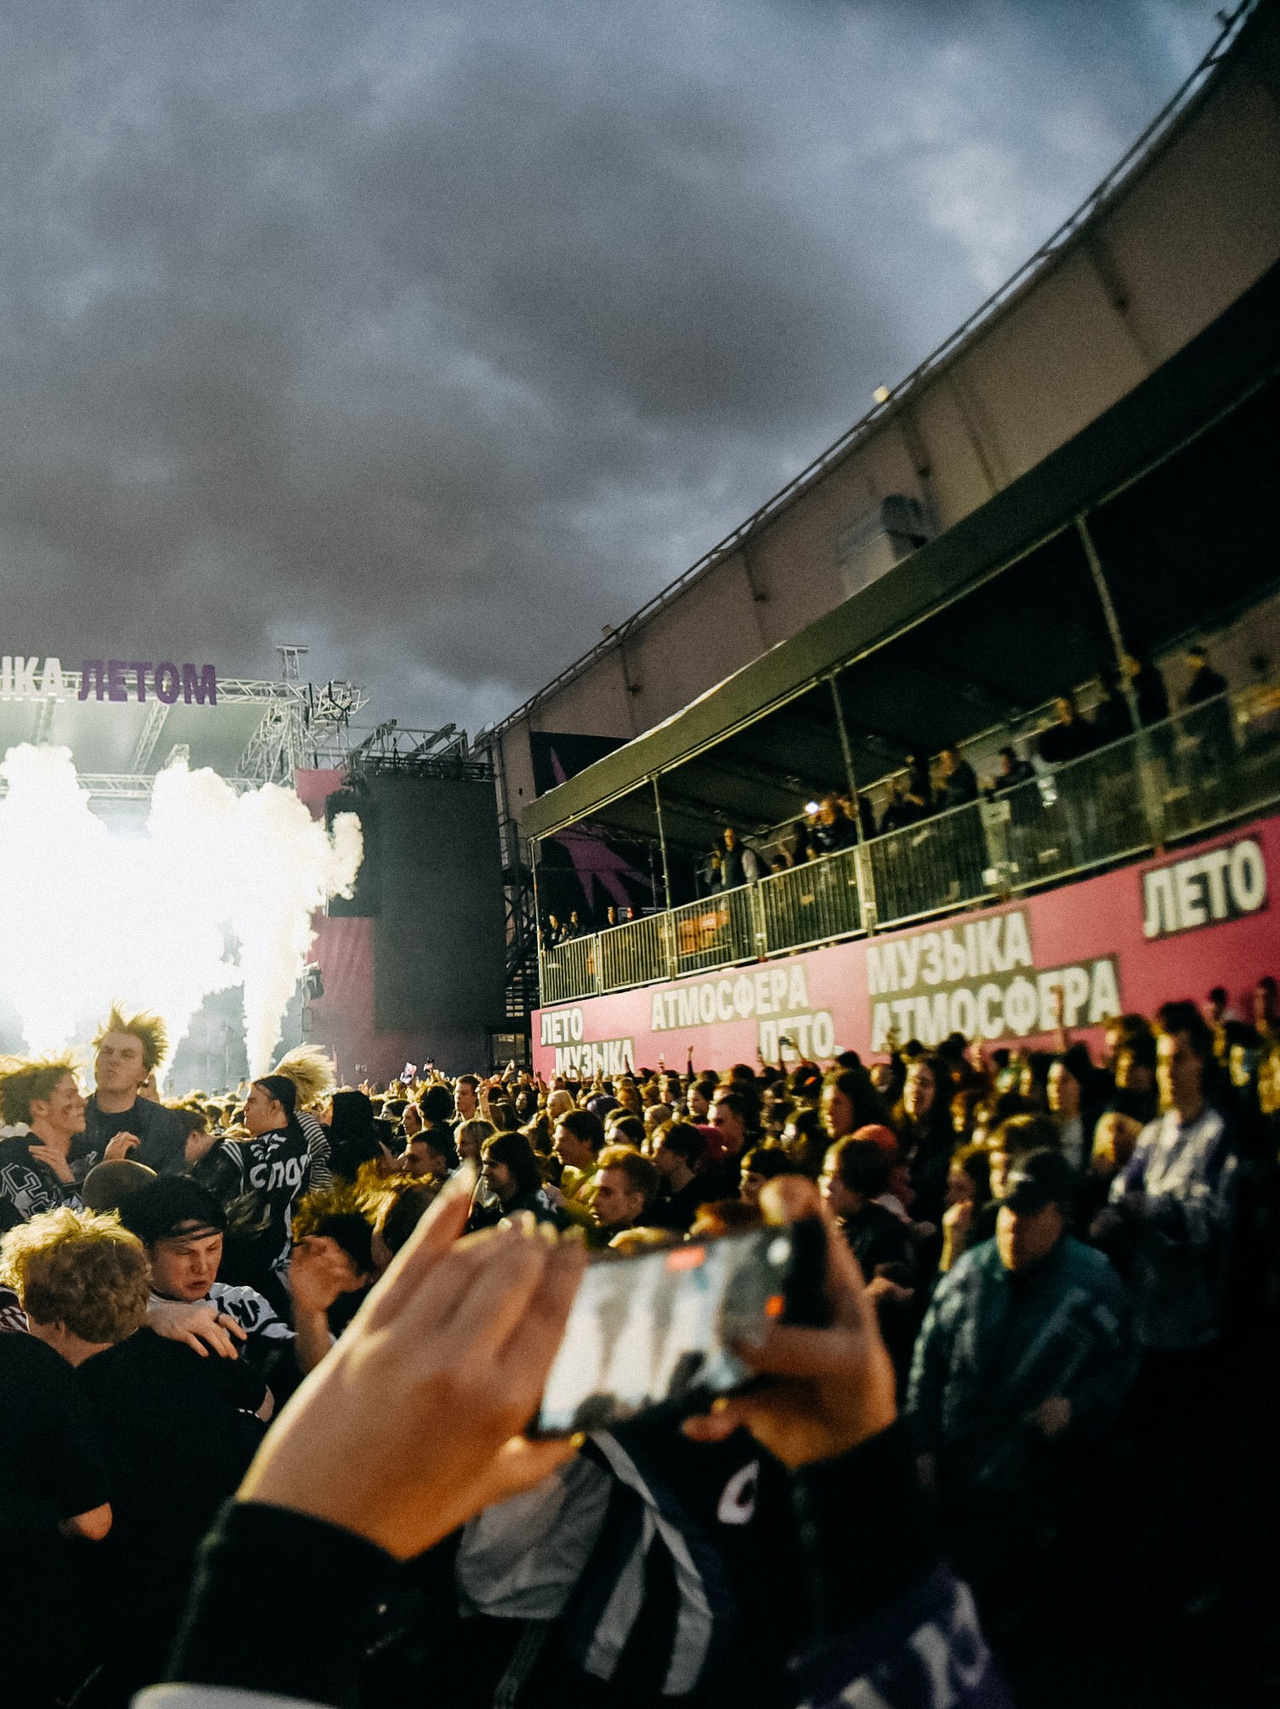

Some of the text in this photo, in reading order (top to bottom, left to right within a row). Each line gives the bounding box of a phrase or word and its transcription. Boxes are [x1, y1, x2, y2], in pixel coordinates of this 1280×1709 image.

[78, 659, 217, 705] ЛЕТОМ
[1143, 840, 1267, 938] ЛЕТО
[866, 911, 1033, 995] МУЗЫКА
[540, 1007, 583, 1046] ЛЕТО
[651, 964, 809, 1031] АТМОСФЕРА
[871, 959, 1123, 1052] АТМОСФЕРА
[555, 1039, 634, 1079] МУЗЫКА
[759, 1012, 835, 1062] ЛЕТО
